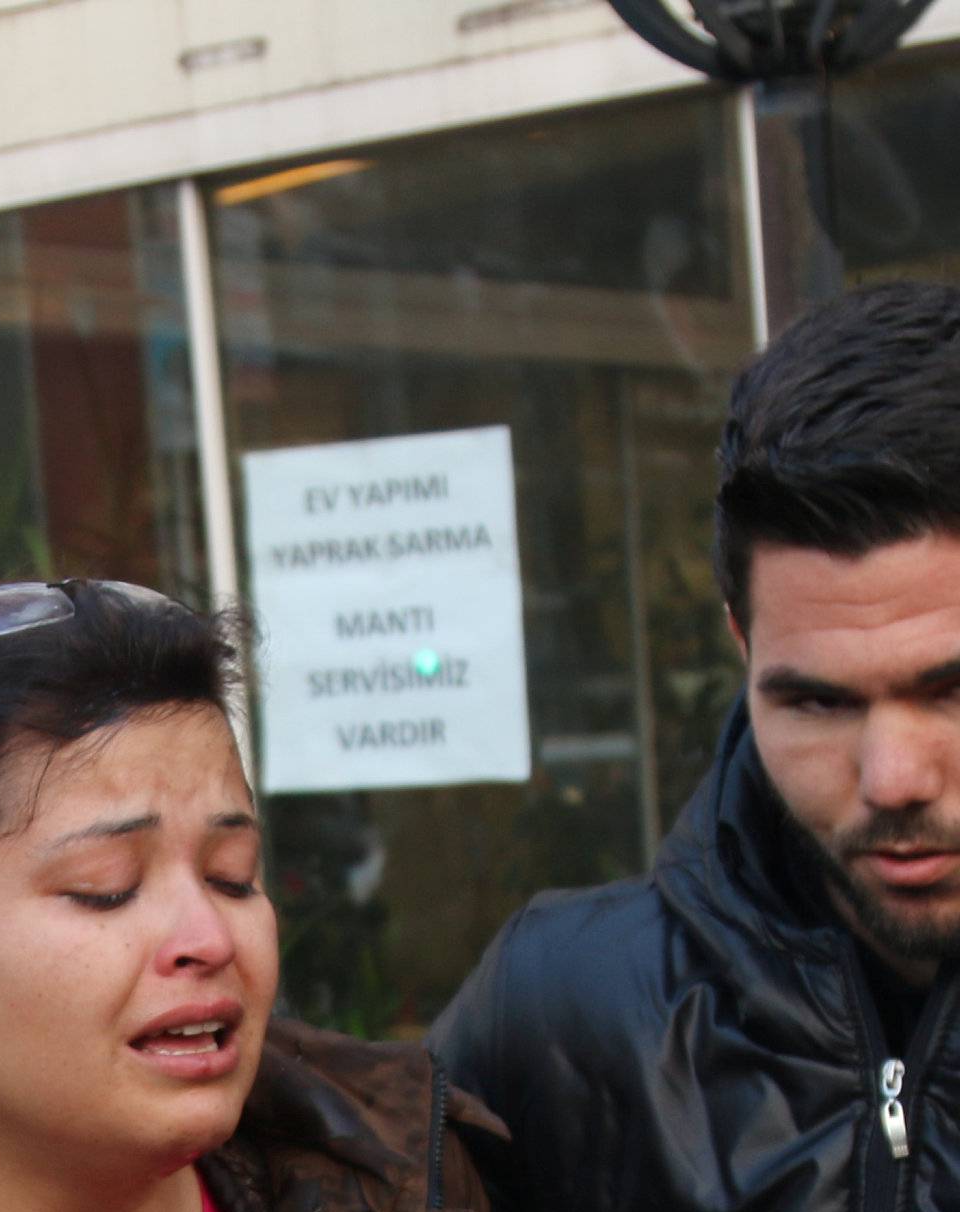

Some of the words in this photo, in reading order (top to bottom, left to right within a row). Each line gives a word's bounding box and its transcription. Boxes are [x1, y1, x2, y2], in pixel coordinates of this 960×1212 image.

[304, 485, 338, 515] EV
[347, 474, 448, 508] YAPIMI
[271, 537, 381, 569] YAPRAK
[387, 522, 492, 560] SARMA
[335, 606, 435, 639] MANTI
[335, 719, 445, 751] VARDIR
